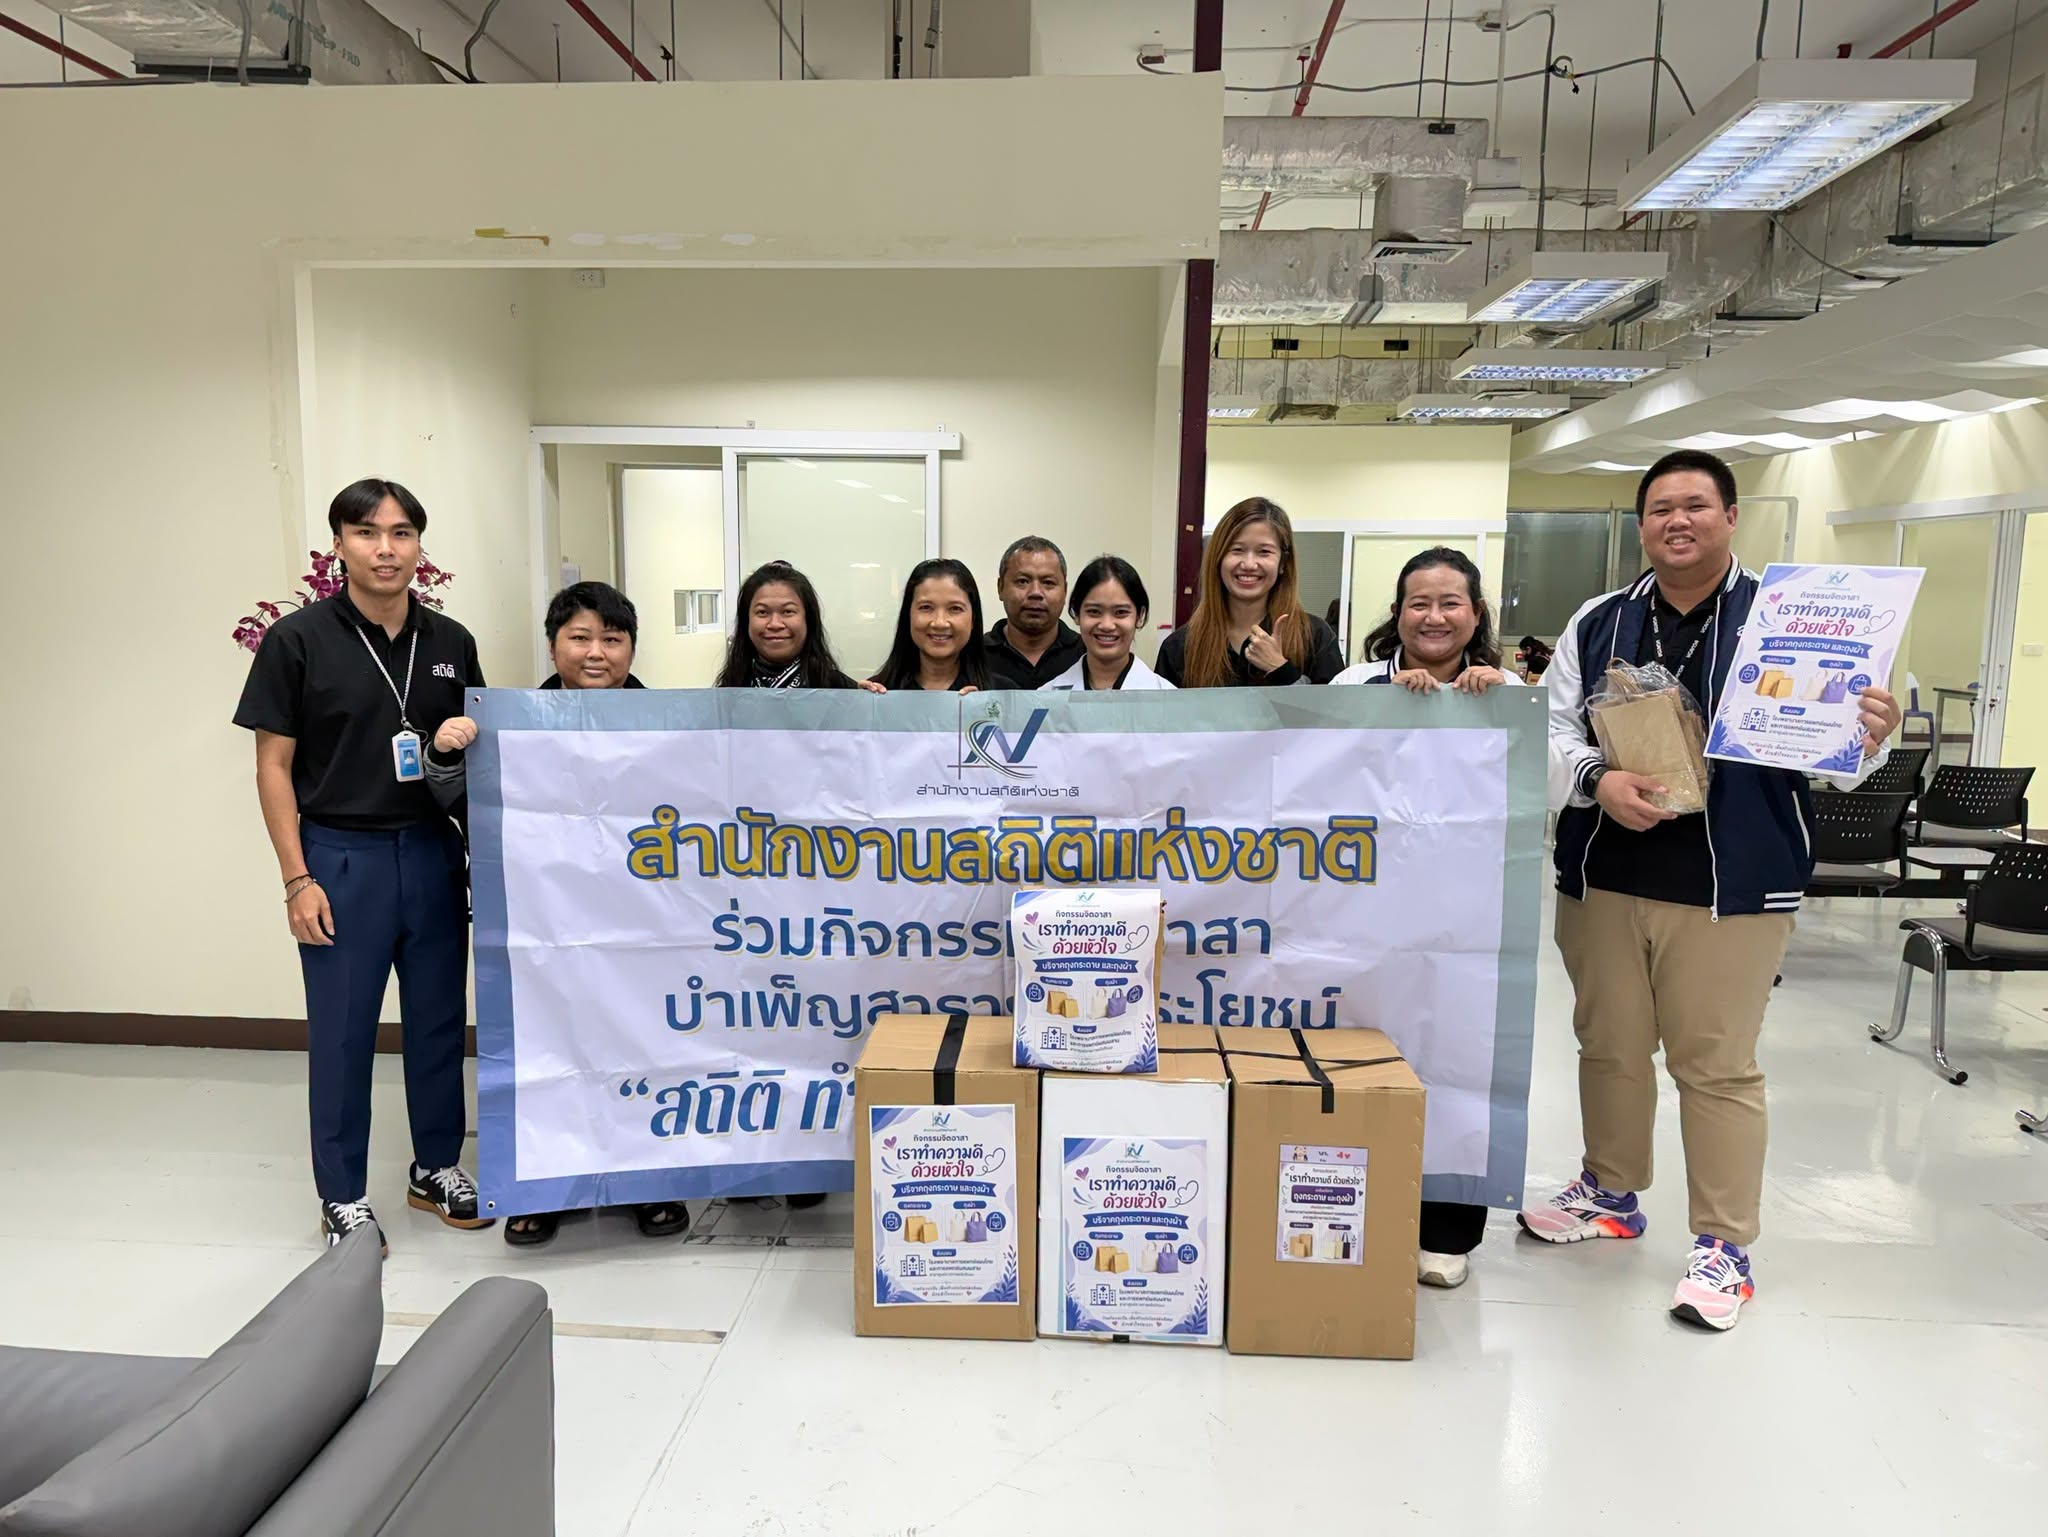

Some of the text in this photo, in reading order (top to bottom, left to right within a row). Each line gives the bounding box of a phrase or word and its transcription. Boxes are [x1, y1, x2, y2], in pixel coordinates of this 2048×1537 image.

[1800, 590, 1860, 601] กิจกรรมจิตอาสา
[1777, 600, 1874, 620] เราทำความดี
[1785, 617, 1855, 637] ด้วยหัวใจ
[1768, 640, 1865, 655] บริจาคถุงกระดาษ และถุงผ้า
[432, 662, 456, 679] สถิติ
[916, 784, 1080, 798] สำนักงานสถิติแห่งชาติ
[627, 804, 1379, 886] สำนักงานสถิติแห่งชาติ
[1055, 910, 1112, 919] กิจกรรมจิตอาสา
[1038, 920, 1127, 937] เราทำความดี
[1052, 937, 1118, 955] ด้วยหัวใจ
[1042, 962, 1133, 973] บริจาคถุงกระดาษ และถุงผ้า
[913, 1134, 969, 1142] กิจกรรมจิตอาสา
[897, 1143, 984, 1161] เราทำความดี
[911, 1161, 975, 1178] ด้วยหัวใจ
[901, 1183, 990, 1195] บริจาคถุงกระดาษ และถุงผ้า
[1089, 1174, 1177, 1191] เราทำความดี
[1103, 1192, 1167, 1209] ด้วยหัวใจ
[1092, 1215, 1183, 1227] บริจาคถุงกระดาษ และถุงผ้า
